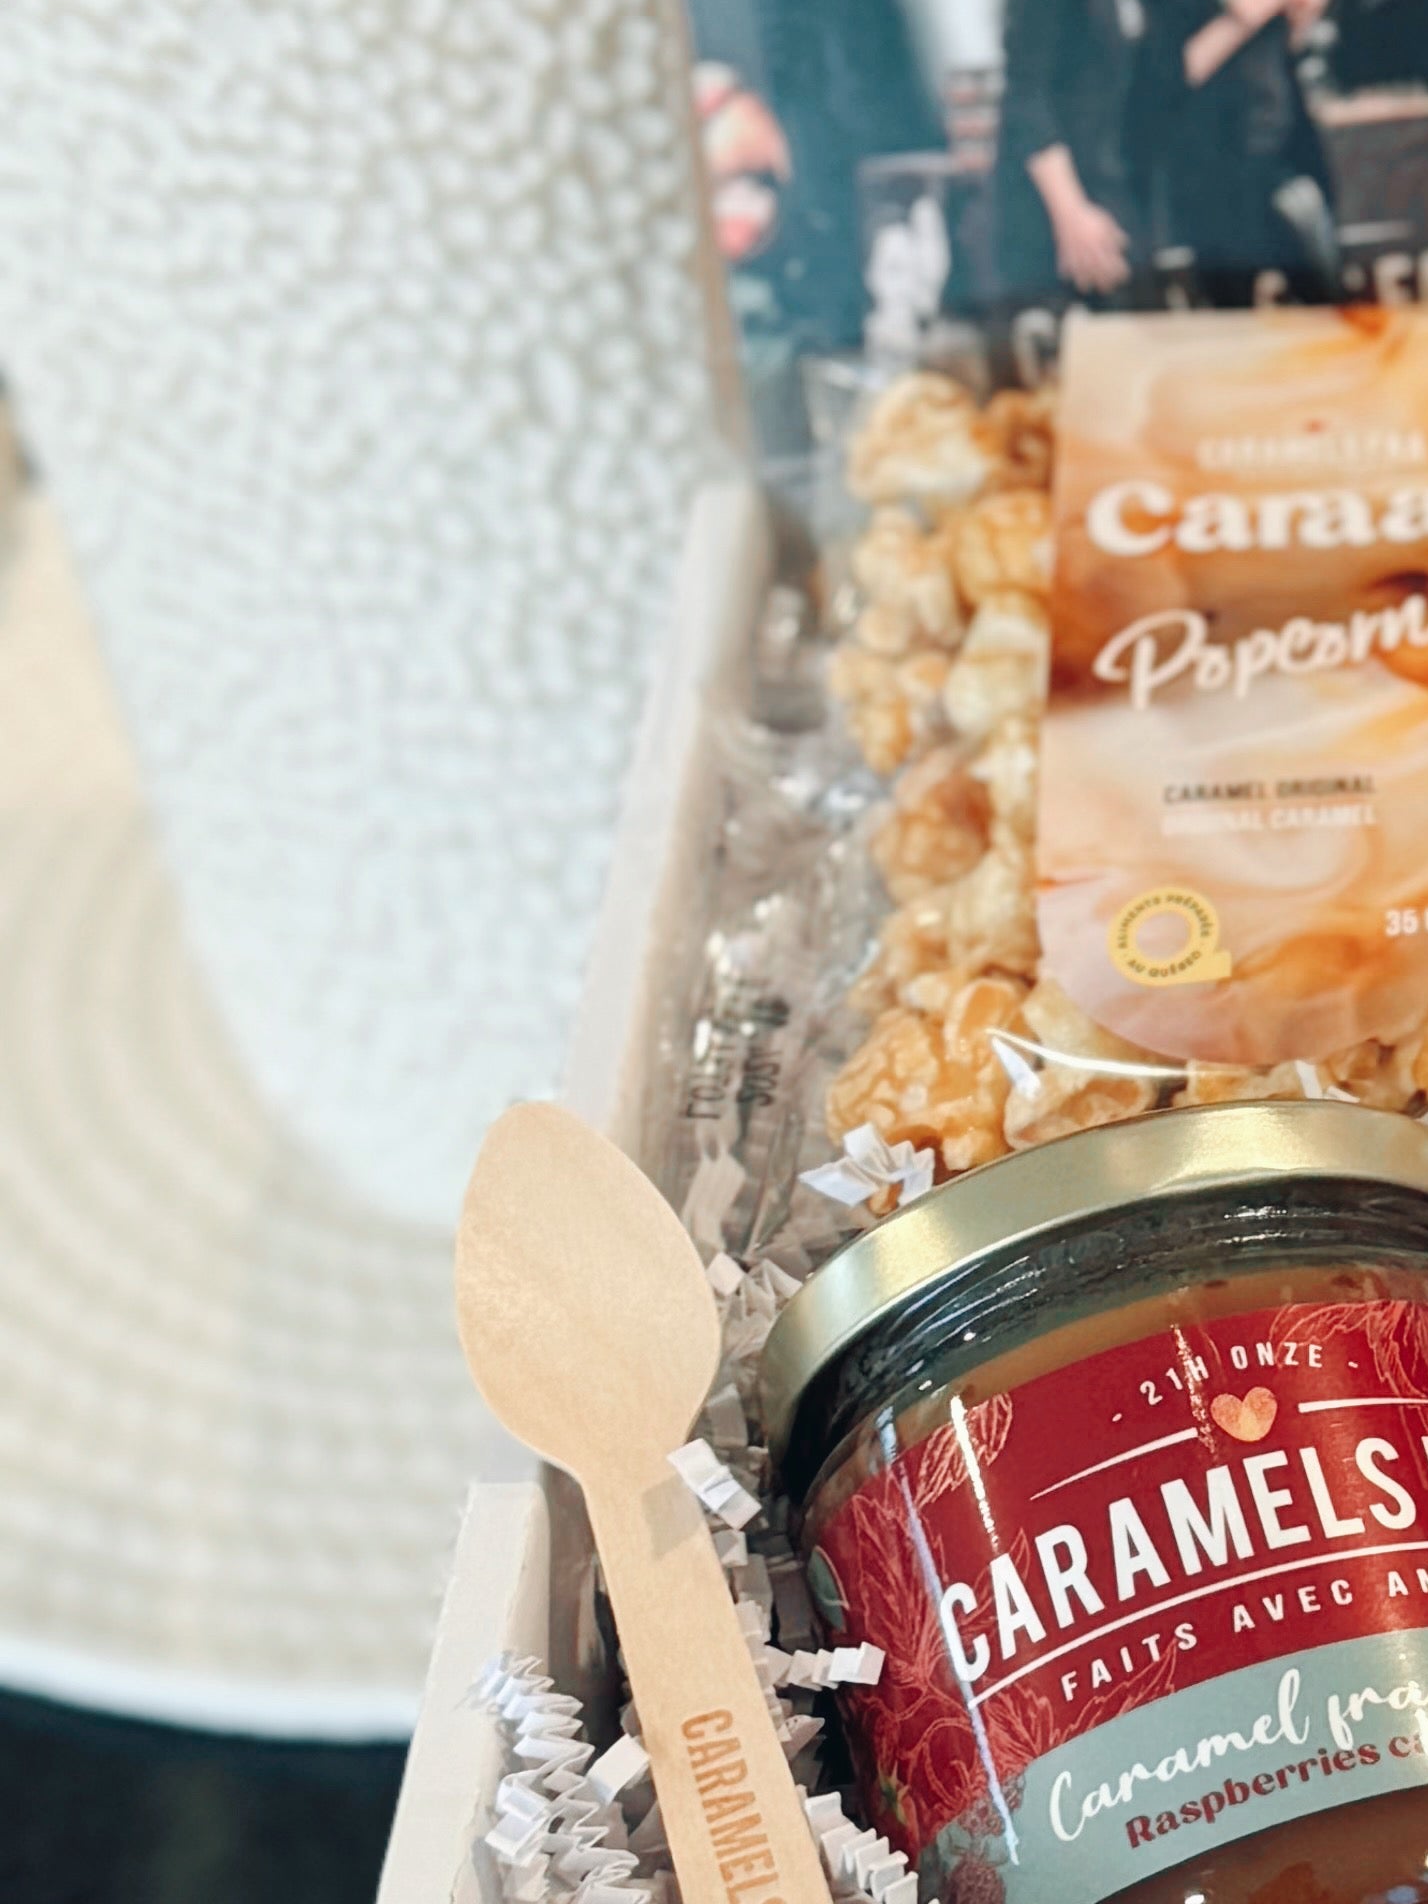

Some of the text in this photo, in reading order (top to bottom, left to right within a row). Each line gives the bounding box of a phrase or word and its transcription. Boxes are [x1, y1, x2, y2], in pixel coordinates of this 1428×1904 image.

[1164, 780, 1267, 804] CARAMEL
[1270, 803, 1377, 829] CARAMEL
[1384, 908, 1418, 938] 35
[1139, 1341, 1323, 1406] 21H ONZE
[939, 1435, 1419, 1685] CARAMELS
[1062, 1620, 1198, 1703] FAITS
[1233, 1577, 1354, 1635] AVEC
[1049, 1667, 1310, 1842] Caramel
[1125, 1742, 1382, 1850] Raspberries
